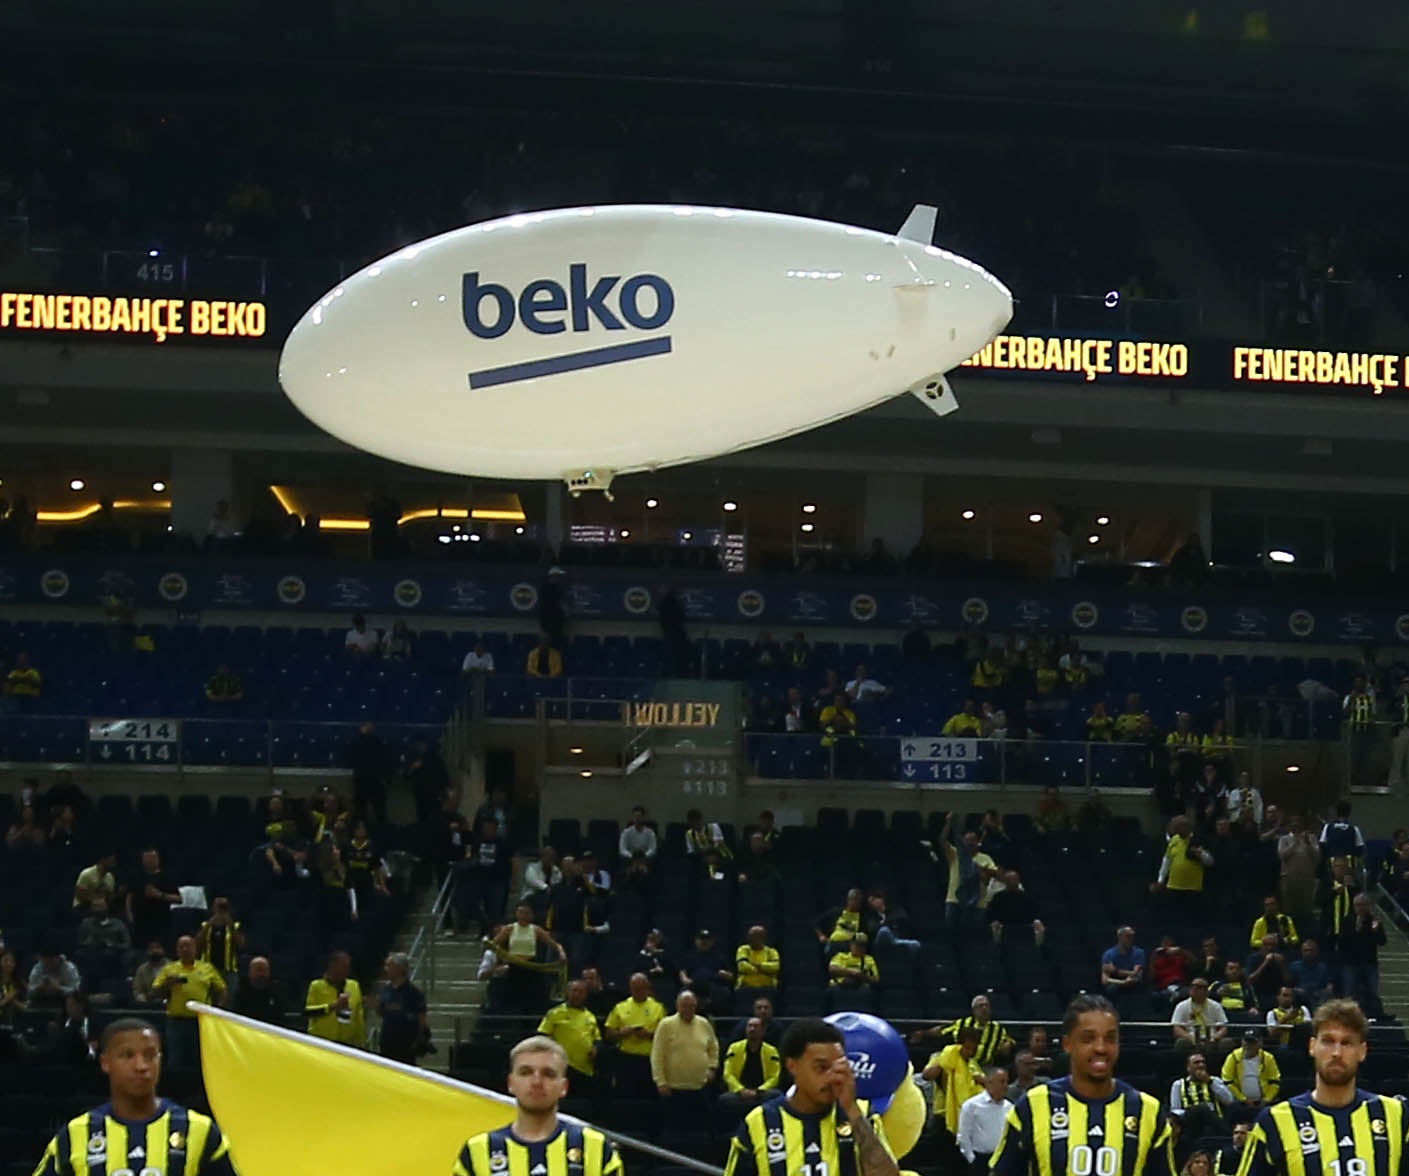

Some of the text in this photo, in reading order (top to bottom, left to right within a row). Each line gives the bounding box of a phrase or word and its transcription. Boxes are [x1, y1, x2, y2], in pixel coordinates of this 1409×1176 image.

[136, 263, 174, 281] 415
[462, 263, 675, 339] beko
[1, 292, 266, 342] FENERBAHÇE BEKO
[960, 334, 1188, 380] NERBAHÇE BEKO
[1234, 347, 1399, 395] FENERBAHÇE
[126, 722, 170, 739] 214
[127, 744, 170, 761] 114
[930, 742, 967, 758] 213
[930, 764, 967, 779] 113
[1072, 1146, 1118, 1176] 00
